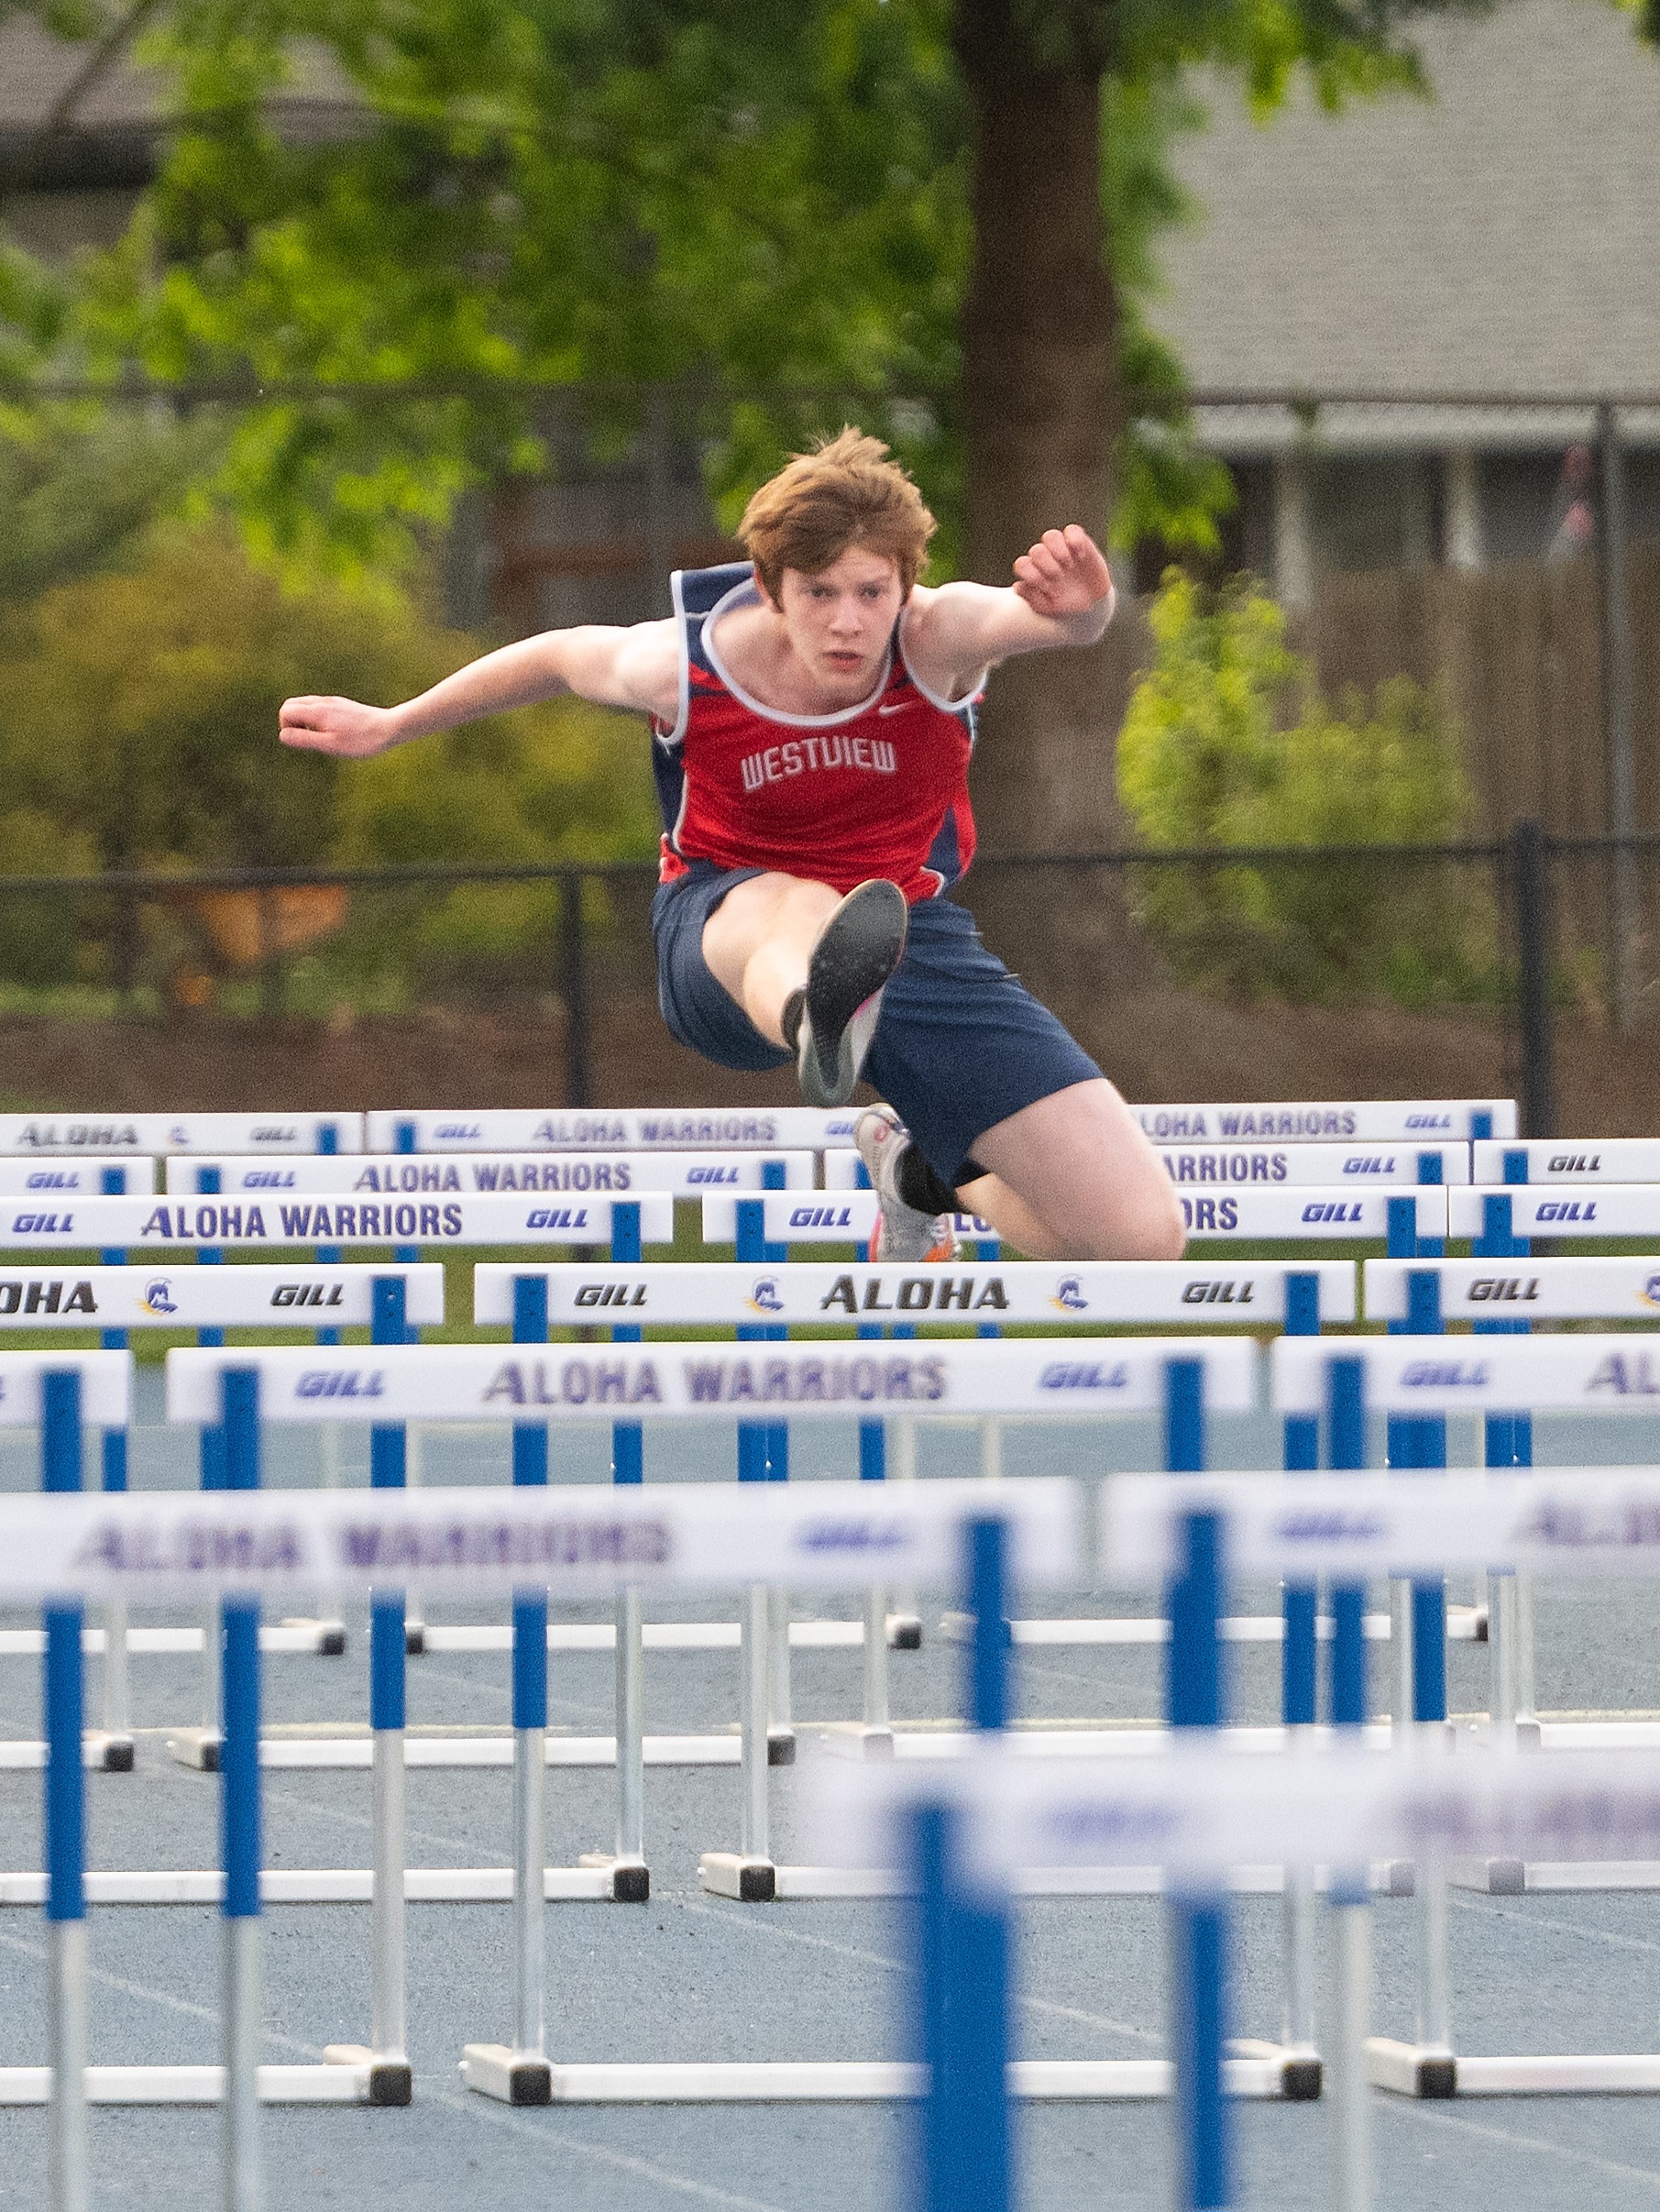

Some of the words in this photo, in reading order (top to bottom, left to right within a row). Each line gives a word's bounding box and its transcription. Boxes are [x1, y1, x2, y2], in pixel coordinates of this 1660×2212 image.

[741, 736, 897, 792] WESTVIEW
[434, 1124, 481, 1139] GILL
[531, 1118, 627, 1142] ALOHA
[637, 1116, 778, 1141] WARRIORS
[1140, 1112, 1207, 1137] LOHA
[1218, 1110, 1357, 1136] WARRIORS
[1405, 1114, 1451, 1128] GILL
[18, 1122, 138, 1146] ALOHA
[687, 1166, 739, 1183] GILL
[1343, 1157, 1395, 1173] GILL
[1548, 1155, 1600, 1172] GILL
[26, 1172, 79, 1189] GILL
[243, 1171, 296, 1188] GILL
[353, 1163, 461, 1193] ALOHA
[472, 1161, 631, 1192] WARRIORS
[12, 1213, 73, 1233] GILL
[140, 1205, 267, 1238] ALOHA
[280, 1204, 463, 1238] WARRIORS
[526, 1208, 588, 1228] GILL
[789, 1207, 852, 1227] GILL
[1302, 1203, 1363, 1223] GILL
[1536, 1202, 1597, 1222] GILL
[0, 1281, 98, 1314] OHA
[270, 1284, 344, 1306] GILL
[574, 1284, 647, 1306] GILL
[820, 1275, 1009, 1314] ALOHA
[1182, 1282, 1255, 1304] GILL
[1467, 1279, 1540, 1301] GILL
[295, 1370, 383, 1399] GILL
[481, 1358, 664, 1405] ALOHA
[683, 1355, 948, 1403] WARRIORS
